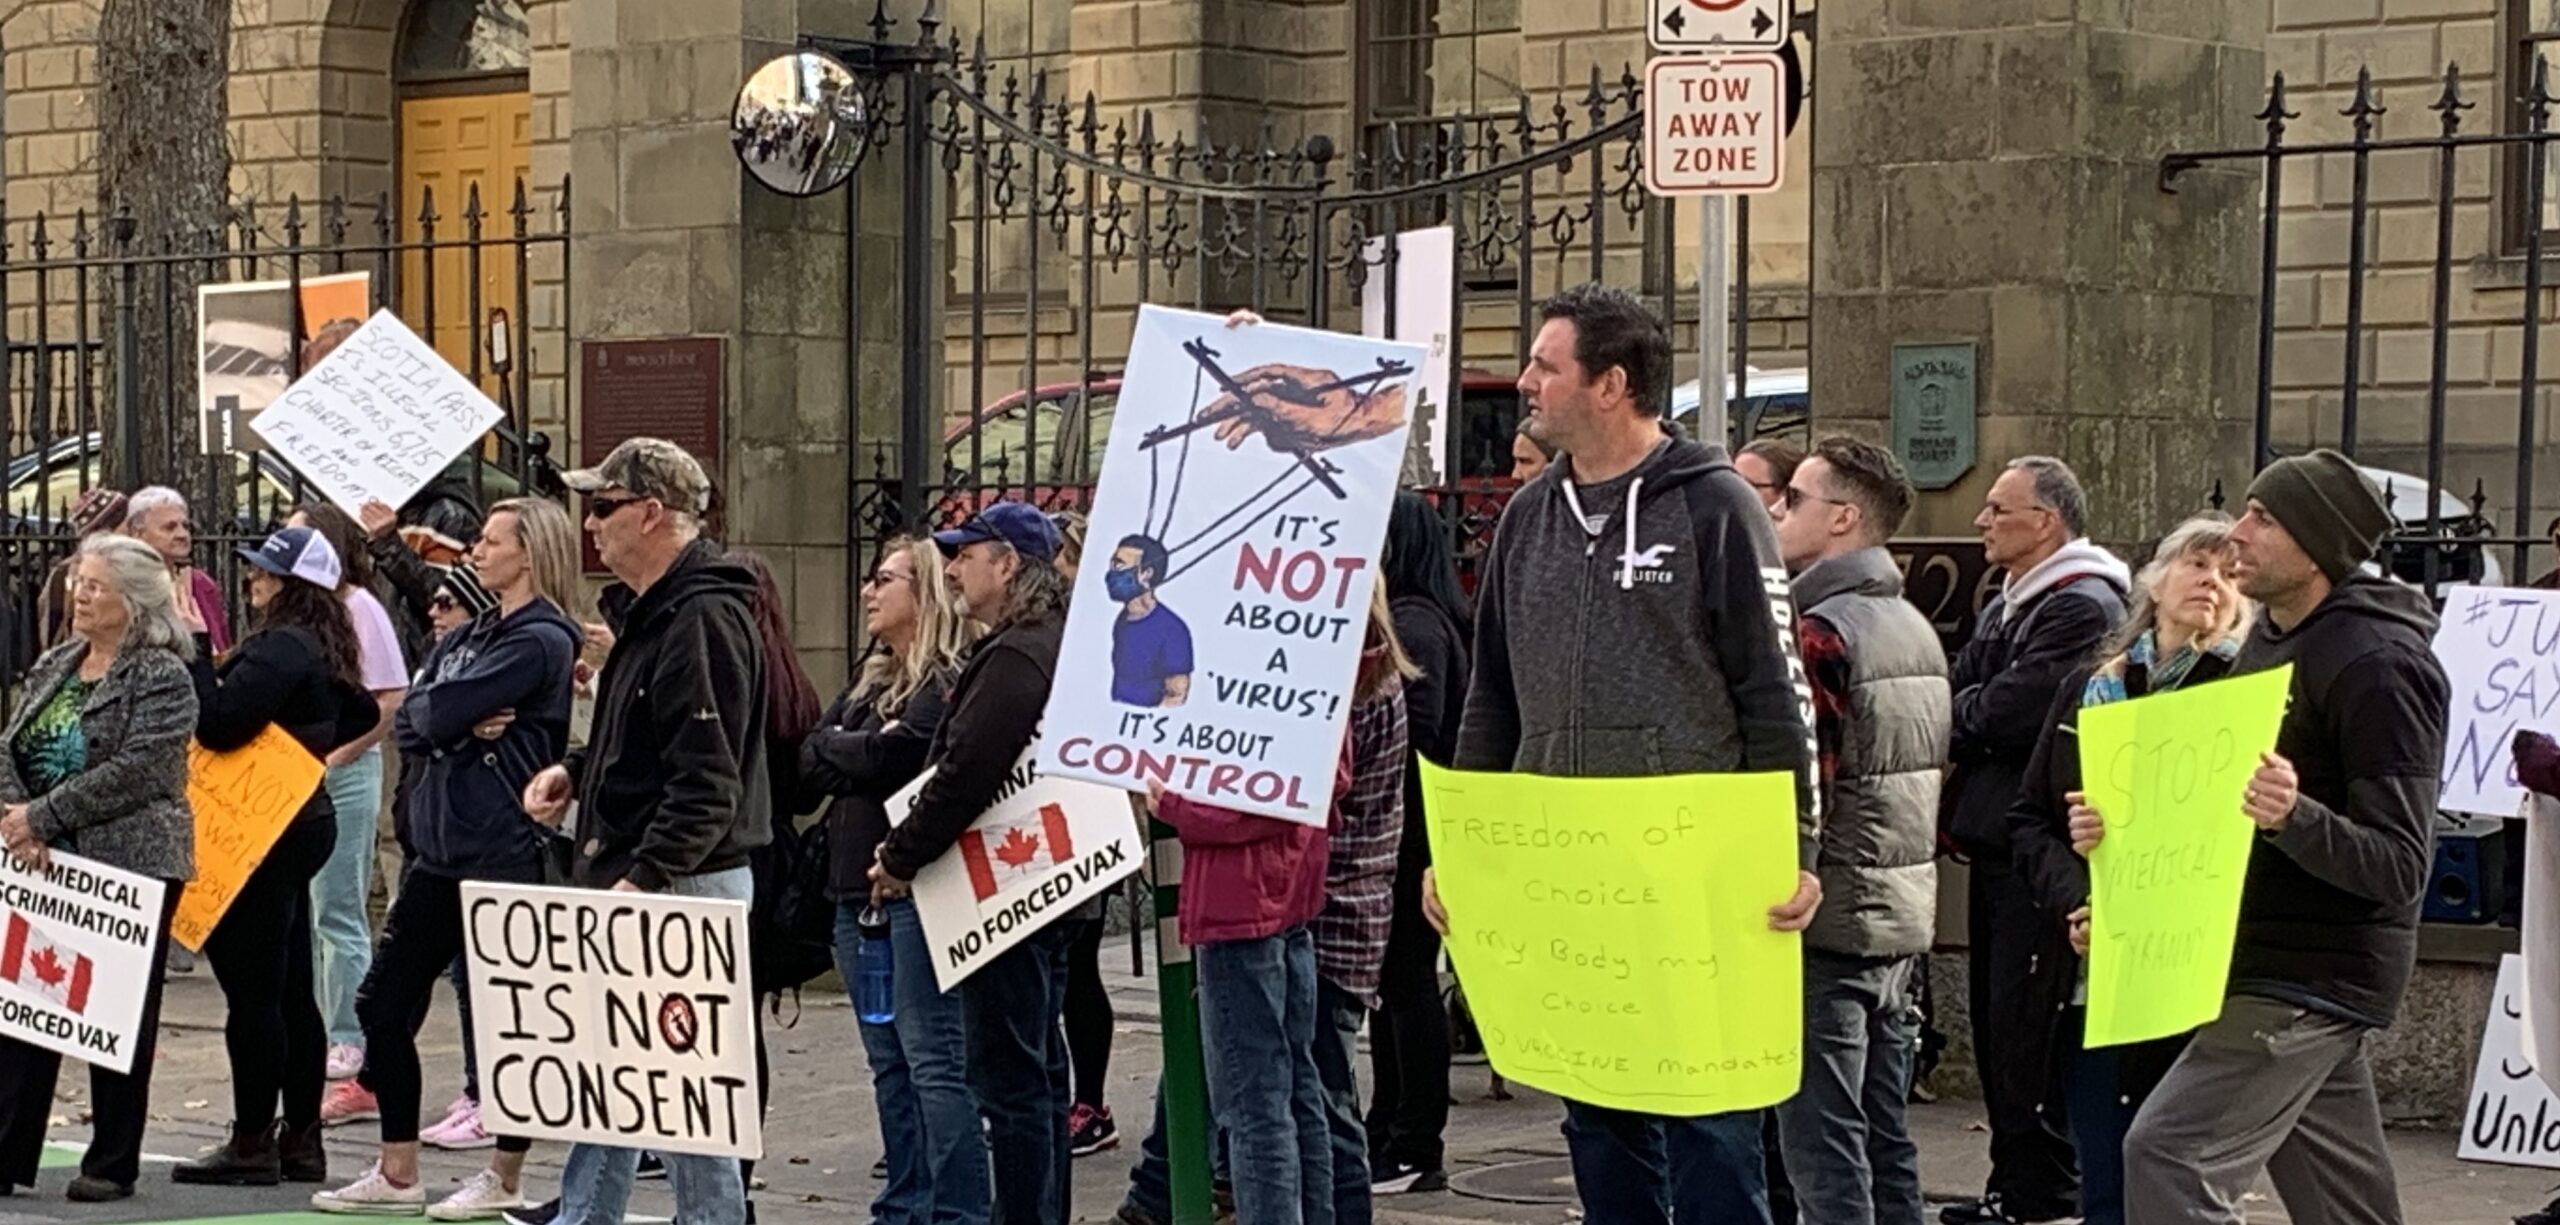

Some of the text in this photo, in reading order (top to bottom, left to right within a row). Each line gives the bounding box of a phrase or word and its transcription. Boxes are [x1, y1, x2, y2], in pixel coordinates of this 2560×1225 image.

[1679, 77, 1751, 103] TOW
[1668, 112, 1762, 138] AWAY
[1673, 147, 1757, 173] ZONE
[315, 366, 396, 432] SECTIONS
[358, 324, 484, 434] SCOTIA PASS
[363, 371, 441, 432] ILLEGAL
[284, 389, 360, 439] CHARTER
[1274, 514, 1340, 547] IT'S
[1233, 542, 1367, 609] NOT
[1224, 601, 1350, 643] ABOUT
[1266, 647, 1288, 674] A
[1119, 711, 1274, 761] IT'S ABOUT
[229, 761, 297, 824] NOT
[1058, 737, 1310, 810] CONTROL
[2109, 727, 2235, 828] STOP
[1643, 805, 1694, 846] of
[0, 846, 141, 910] TO MEDICAL
[2106, 838, 2221, 902] MEDICAL
[947, 839, 1126, 968] NO FORCED VAX
[470, 897, 736, 984] COERCION
[1551, 938, 1630, 979] Body
[2109, 916, 2210, 988] TYRANNY
[489, 977, 730, 1057] IS NOT
[1541, 992, 1641, 1015] Choice
[78, 1022, 120, 1057] VAX
[493, 1054, 746, 1146] CONSENT
